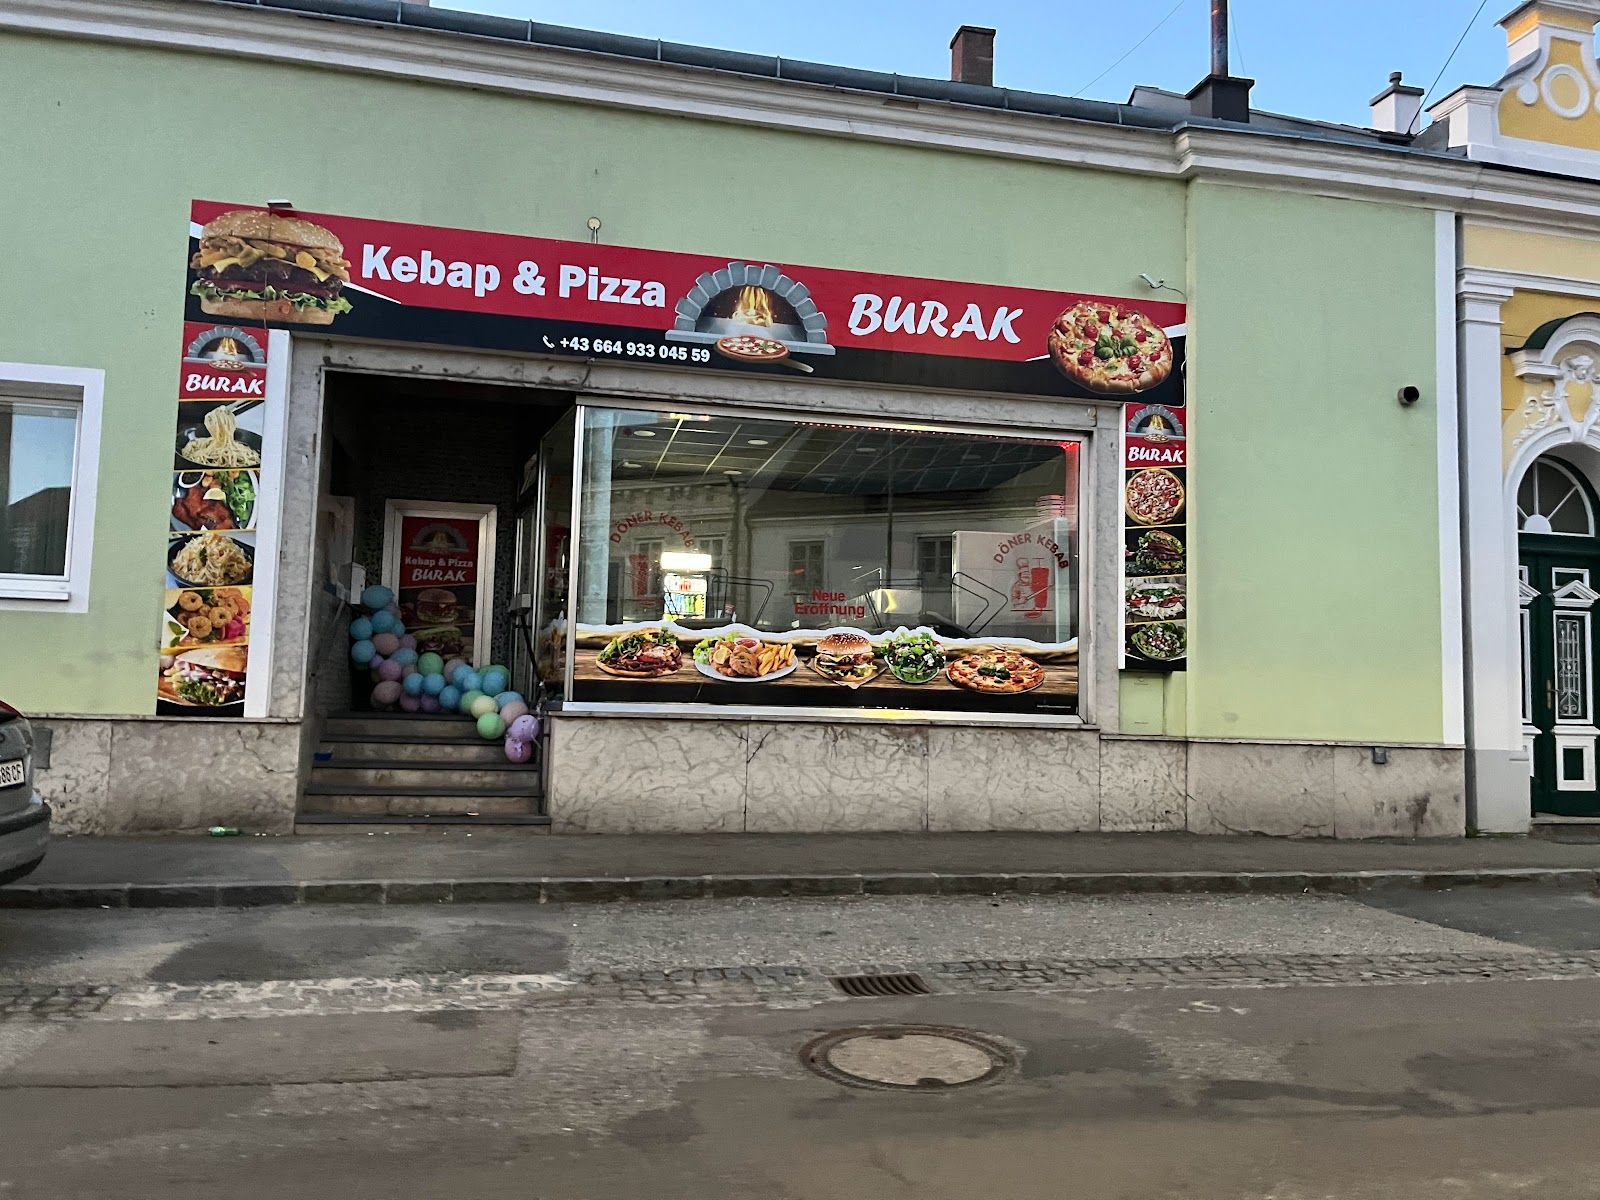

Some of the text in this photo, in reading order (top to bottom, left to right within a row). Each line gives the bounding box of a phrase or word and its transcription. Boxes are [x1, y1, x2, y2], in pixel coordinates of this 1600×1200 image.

[362, 243, 666, 308] Kebap & Pizza
[847, 293, 1024, 344] BURAK
[560, 336, 712, 363] +43 664 933 045 59
[185, 373, 264, 396] BURAK
[1128, 446, 1184, 464] BURAK
[610, 510, 695, 548] DÖNER KEBAB
[405, 556, 473, 567] Kebap & Pizza
[993, 533, 1069, 569] DÖNER KEBAB
[411, 568, 467, 582] BURAK
[812, 588, 845, 601] Neue
[795, 602, 865, 618] Eröffnung
